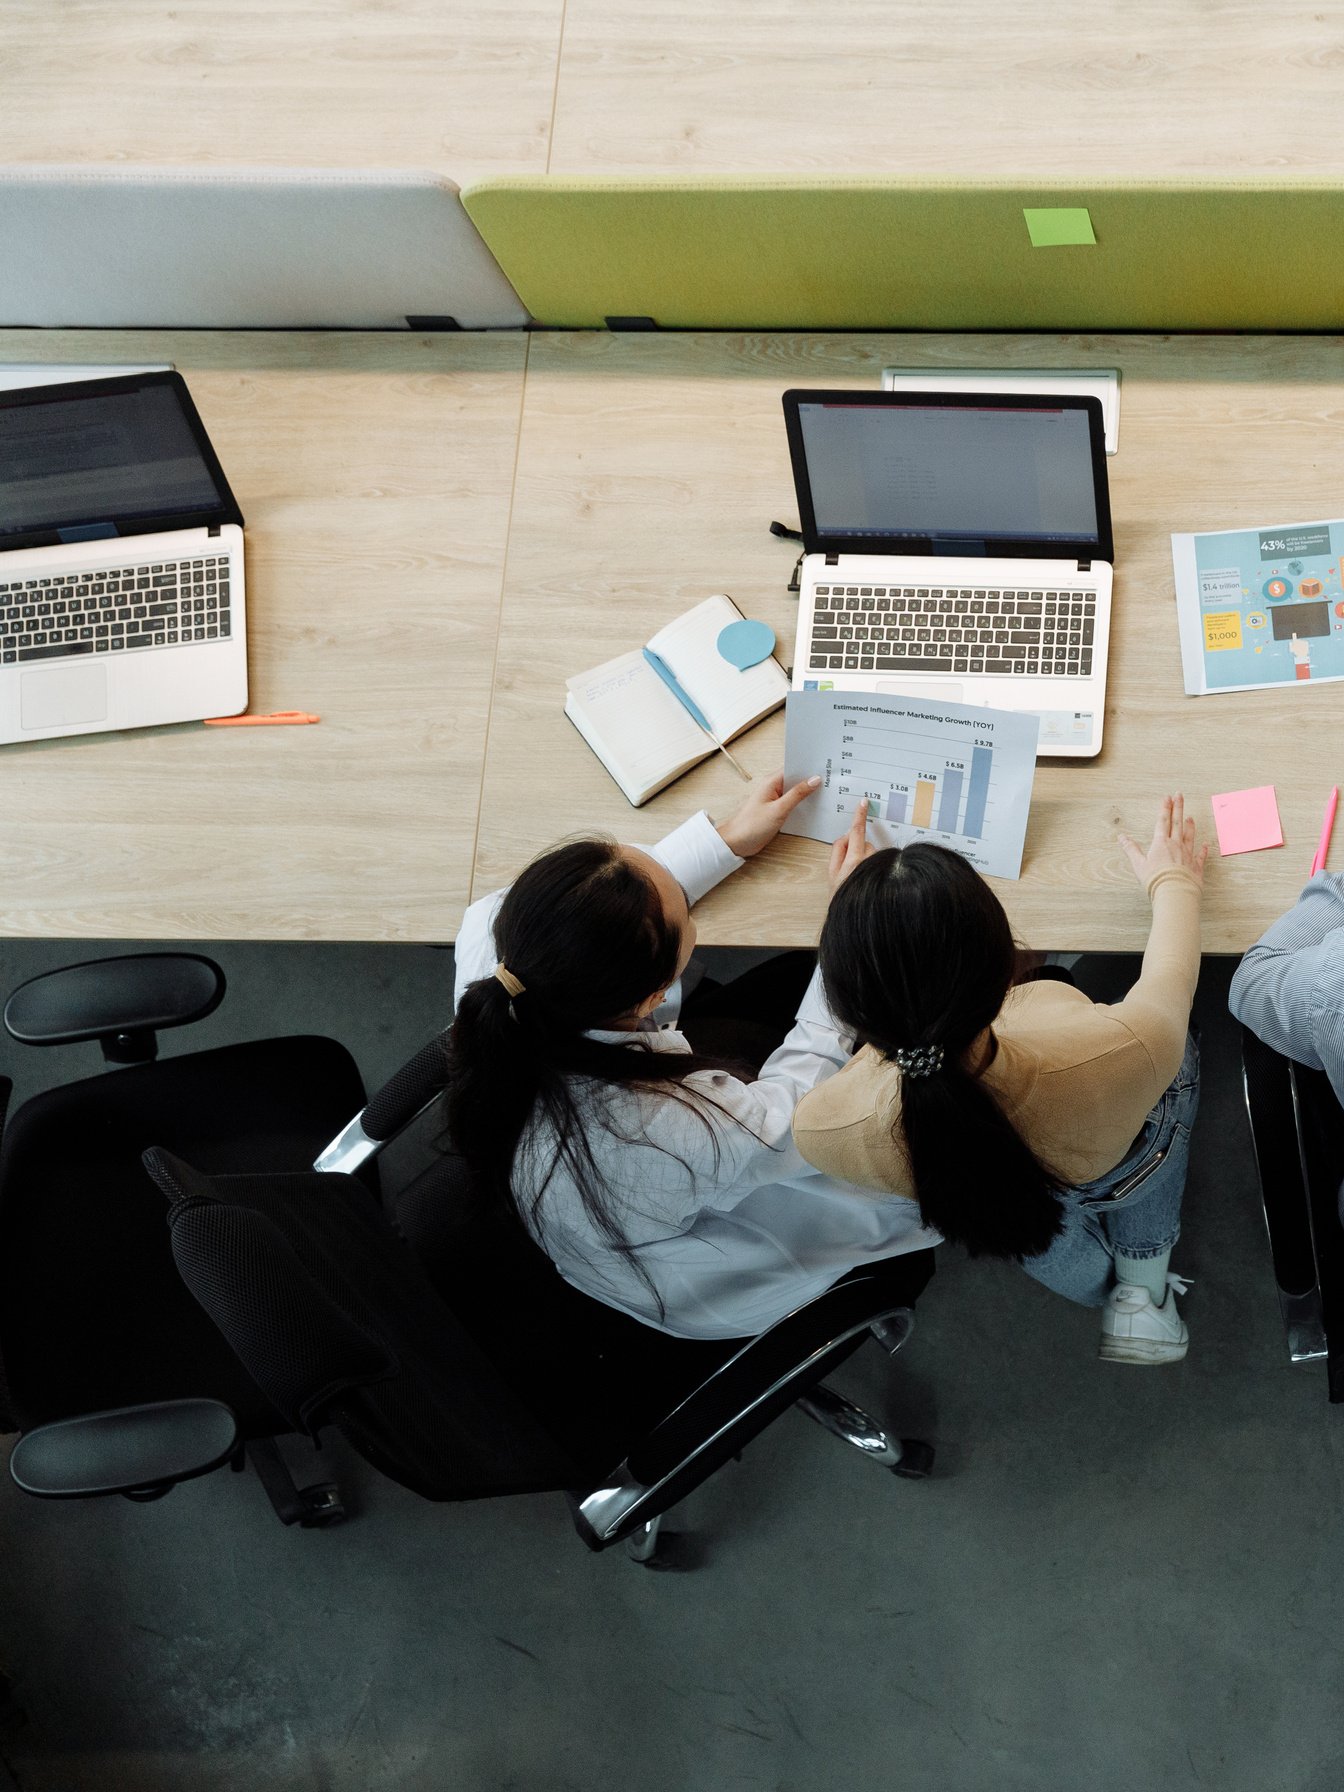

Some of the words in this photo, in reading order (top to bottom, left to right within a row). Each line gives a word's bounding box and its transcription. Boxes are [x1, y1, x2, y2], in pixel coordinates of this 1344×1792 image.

[1261, 540, 1285, 551] 43%
[1208, 632, 1237, 640] $1,000
[870, 706, 905, 716] Influencer
[907, 711, 943, 722] Marketing
[945, 716, 972, 726] Growth
